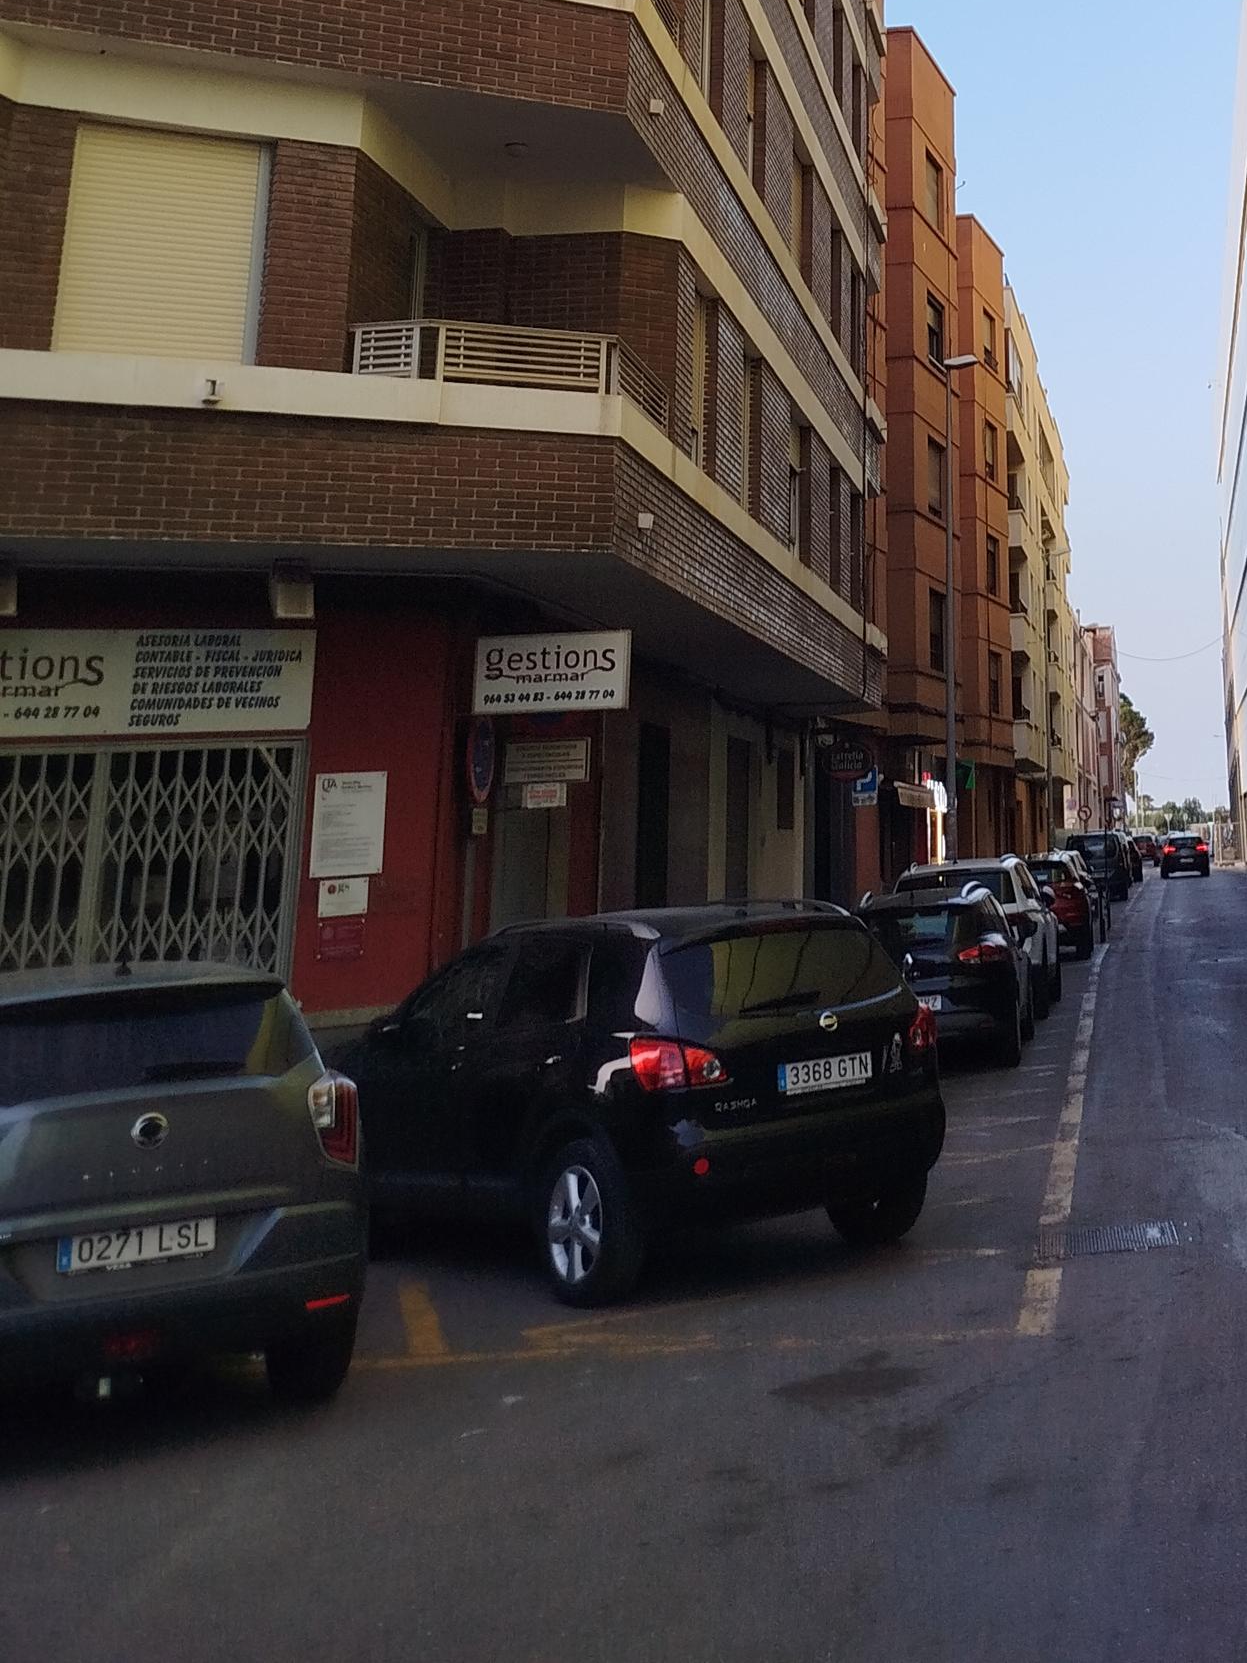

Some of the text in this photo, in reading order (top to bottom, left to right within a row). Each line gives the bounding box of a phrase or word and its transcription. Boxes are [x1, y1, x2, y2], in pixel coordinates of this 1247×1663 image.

[136, 635, 241, 647] ASESORIA LABORAL
[135, 650, 193, 663] CONTABLE
[205, 650, 241, 662] FISCAL
[484, 644, 616, 680] gestions
[132, 665, 282, 679] SERVICIOS DE PREVENCION
[515, 671, 587, 684] marmar
[132, 681, 263, 695] DE RIESGOS LABORALES
[130, 696, 281, 711] COMUNIDADES DE VECINOS
[484, 694, 501, 705] 964
[503, 693, 515, 703] 53
[518, 692, 530, 703] 44
[554, 690, 572, 701] 644
[575, 690, 586, 700] 28
[589, 689, 600, 700] 77
[603, 689, 615, 699] 04
[14, 707, 40, 719] 644
[44, 706, 60, 718] 28
[64, 706, 80, 718] 77
[83, 705, 100, 718] 04
[128, 714, 181, 727] SEGUROS
[789, 1054, 870, 1085] 3368 GTN
[714, 1098, 758, 1113] QASHQA
[78, 1222, 209, 1263] 0271 LSL
